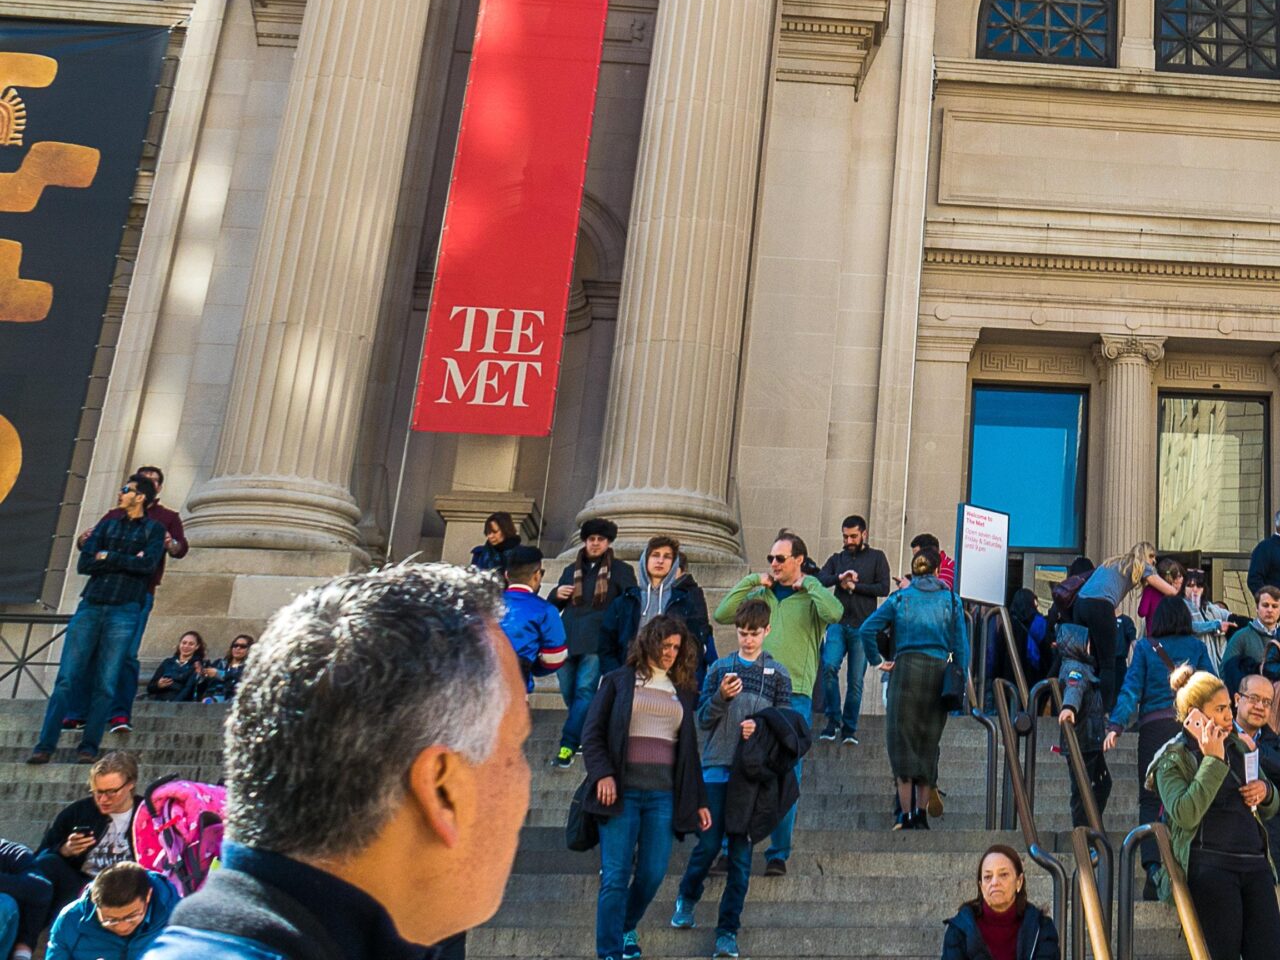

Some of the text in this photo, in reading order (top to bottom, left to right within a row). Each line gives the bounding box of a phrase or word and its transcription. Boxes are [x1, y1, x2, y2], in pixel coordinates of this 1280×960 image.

[449, 305, 545, 356] THE
[434, 357, 542, 407] MET
[975, 519, 985, 527] Met
